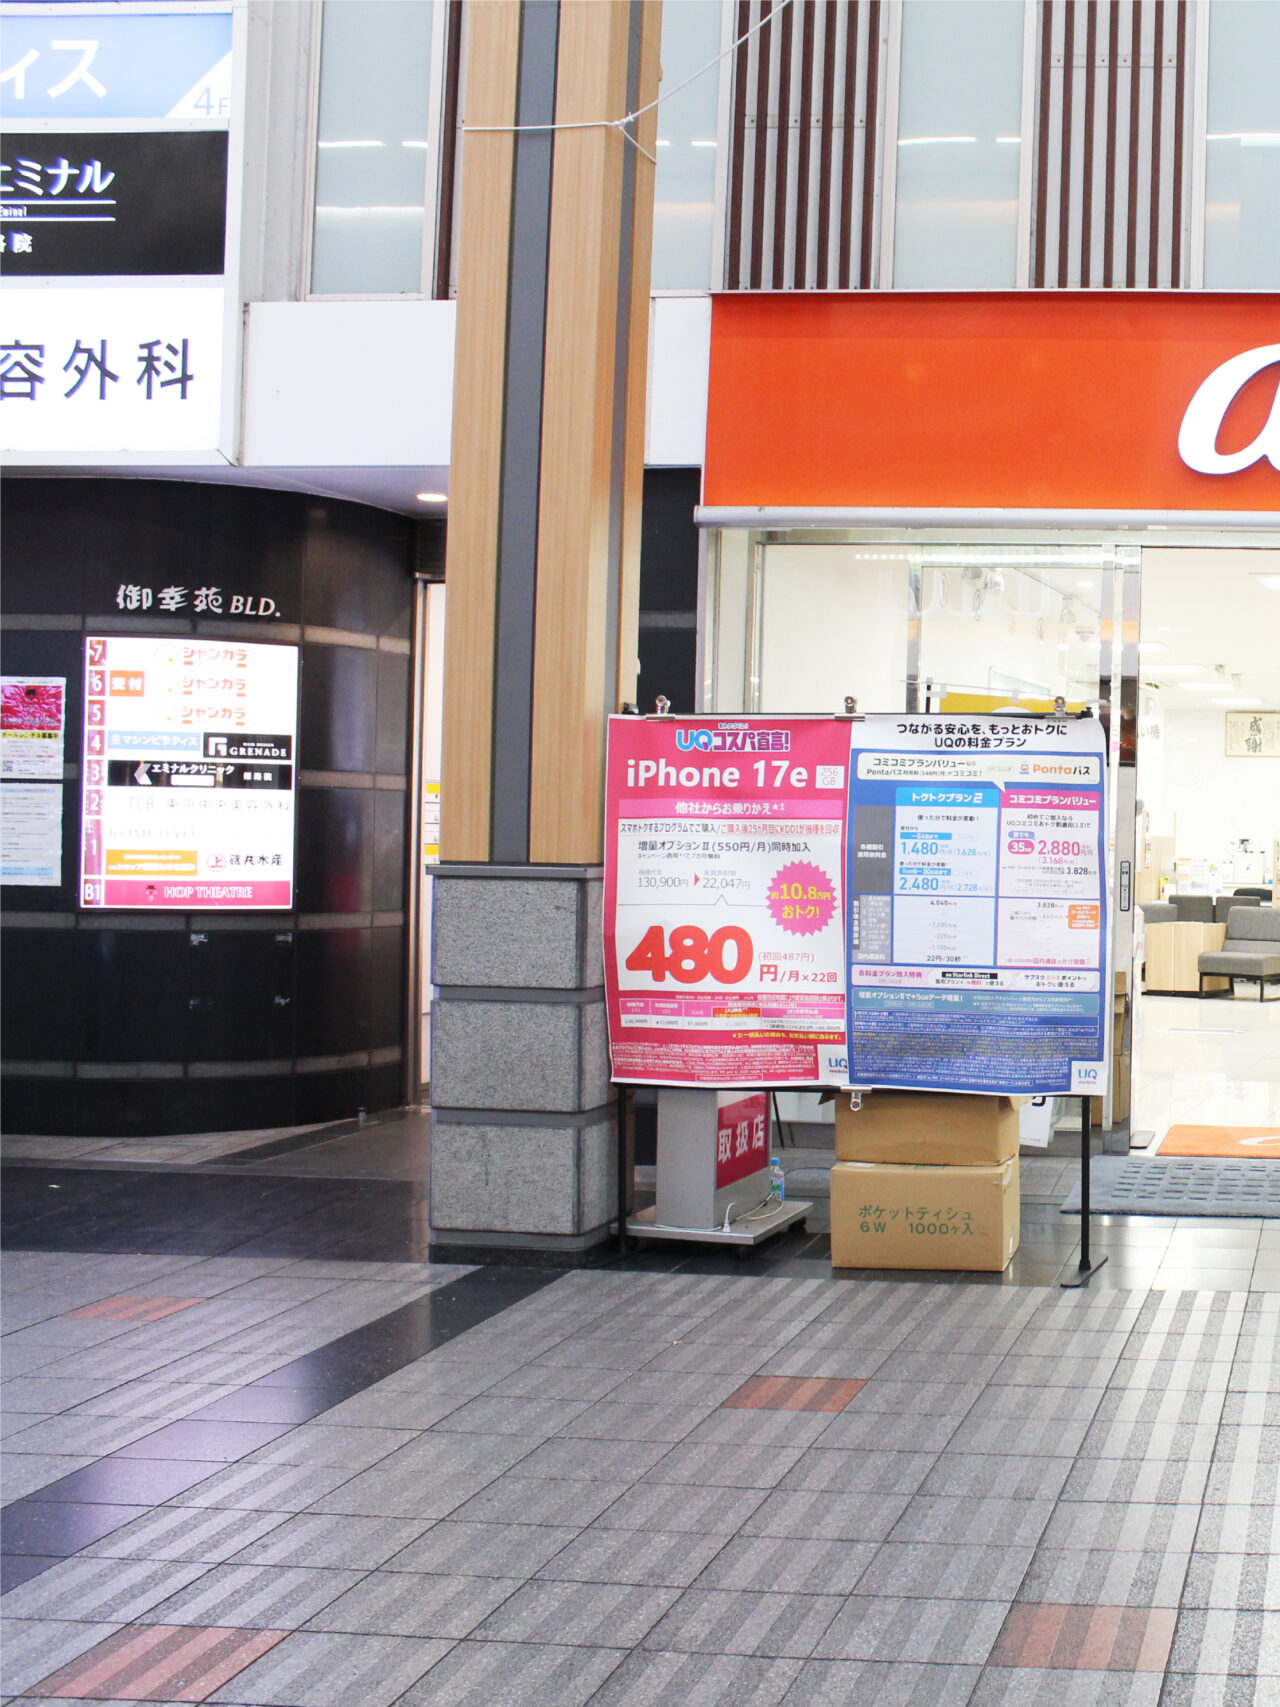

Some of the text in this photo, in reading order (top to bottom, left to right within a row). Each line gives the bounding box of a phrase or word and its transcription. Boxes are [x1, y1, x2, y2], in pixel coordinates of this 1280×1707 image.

[0, 338, 194, 400] 容外科
[116, 584, 281, 617] 御幸苑 BLD.
[183, 647, 247, 662] シャンカラ
[94, 674, 103, 691] 6
[183, 676, 246, 691] シャンカラ
[92, 705, 101, 722] 5
[182, 706, 246, 720] シャンカラ
[897, 723, 1067, 736] つながる安心を、もっとおトクに
[91, 735, 101, 751] 4
[121, 734, 198, 747] マシンピラティス
[676, 729, 791, 752] UQコスパ宣言!
[934, 737, 1027, 749] UQの料金プラン
[229, 747, 287, 757] GRENADE
[92, 763, 100, 780] 3
[151, 763, 235, 775] エミナルクリニック
[627, 758, 809, 788] iPhone 17e
[1033, 763, 1091, 776] Pontaパス
[90, 794, 99, 811] 2
[1009, 794, 1097, 806] コミコミプランバリュー
[90, 839, 97, 856] 1
[901, 841, 939, 856] 1,480
[1037, 839, 1081, 856] 2,880
[638, 876, 689, 889] 130,900円
[899, 877, 939, 891] 2,480
[85, 883, 100, 900] B1
[164, 887, 253, 898] HOP THEATRE
[782, 905, 820, 918] おトク!
[626, 924, 754, 984] 480
[828, 1057, 848, 1070] UQ
[1078, 1067, 1098, 1080] UQ
[718, 1114, 764, 1163] 取扱店
[858, 1205, 974, 1221] ポケットティシュ
